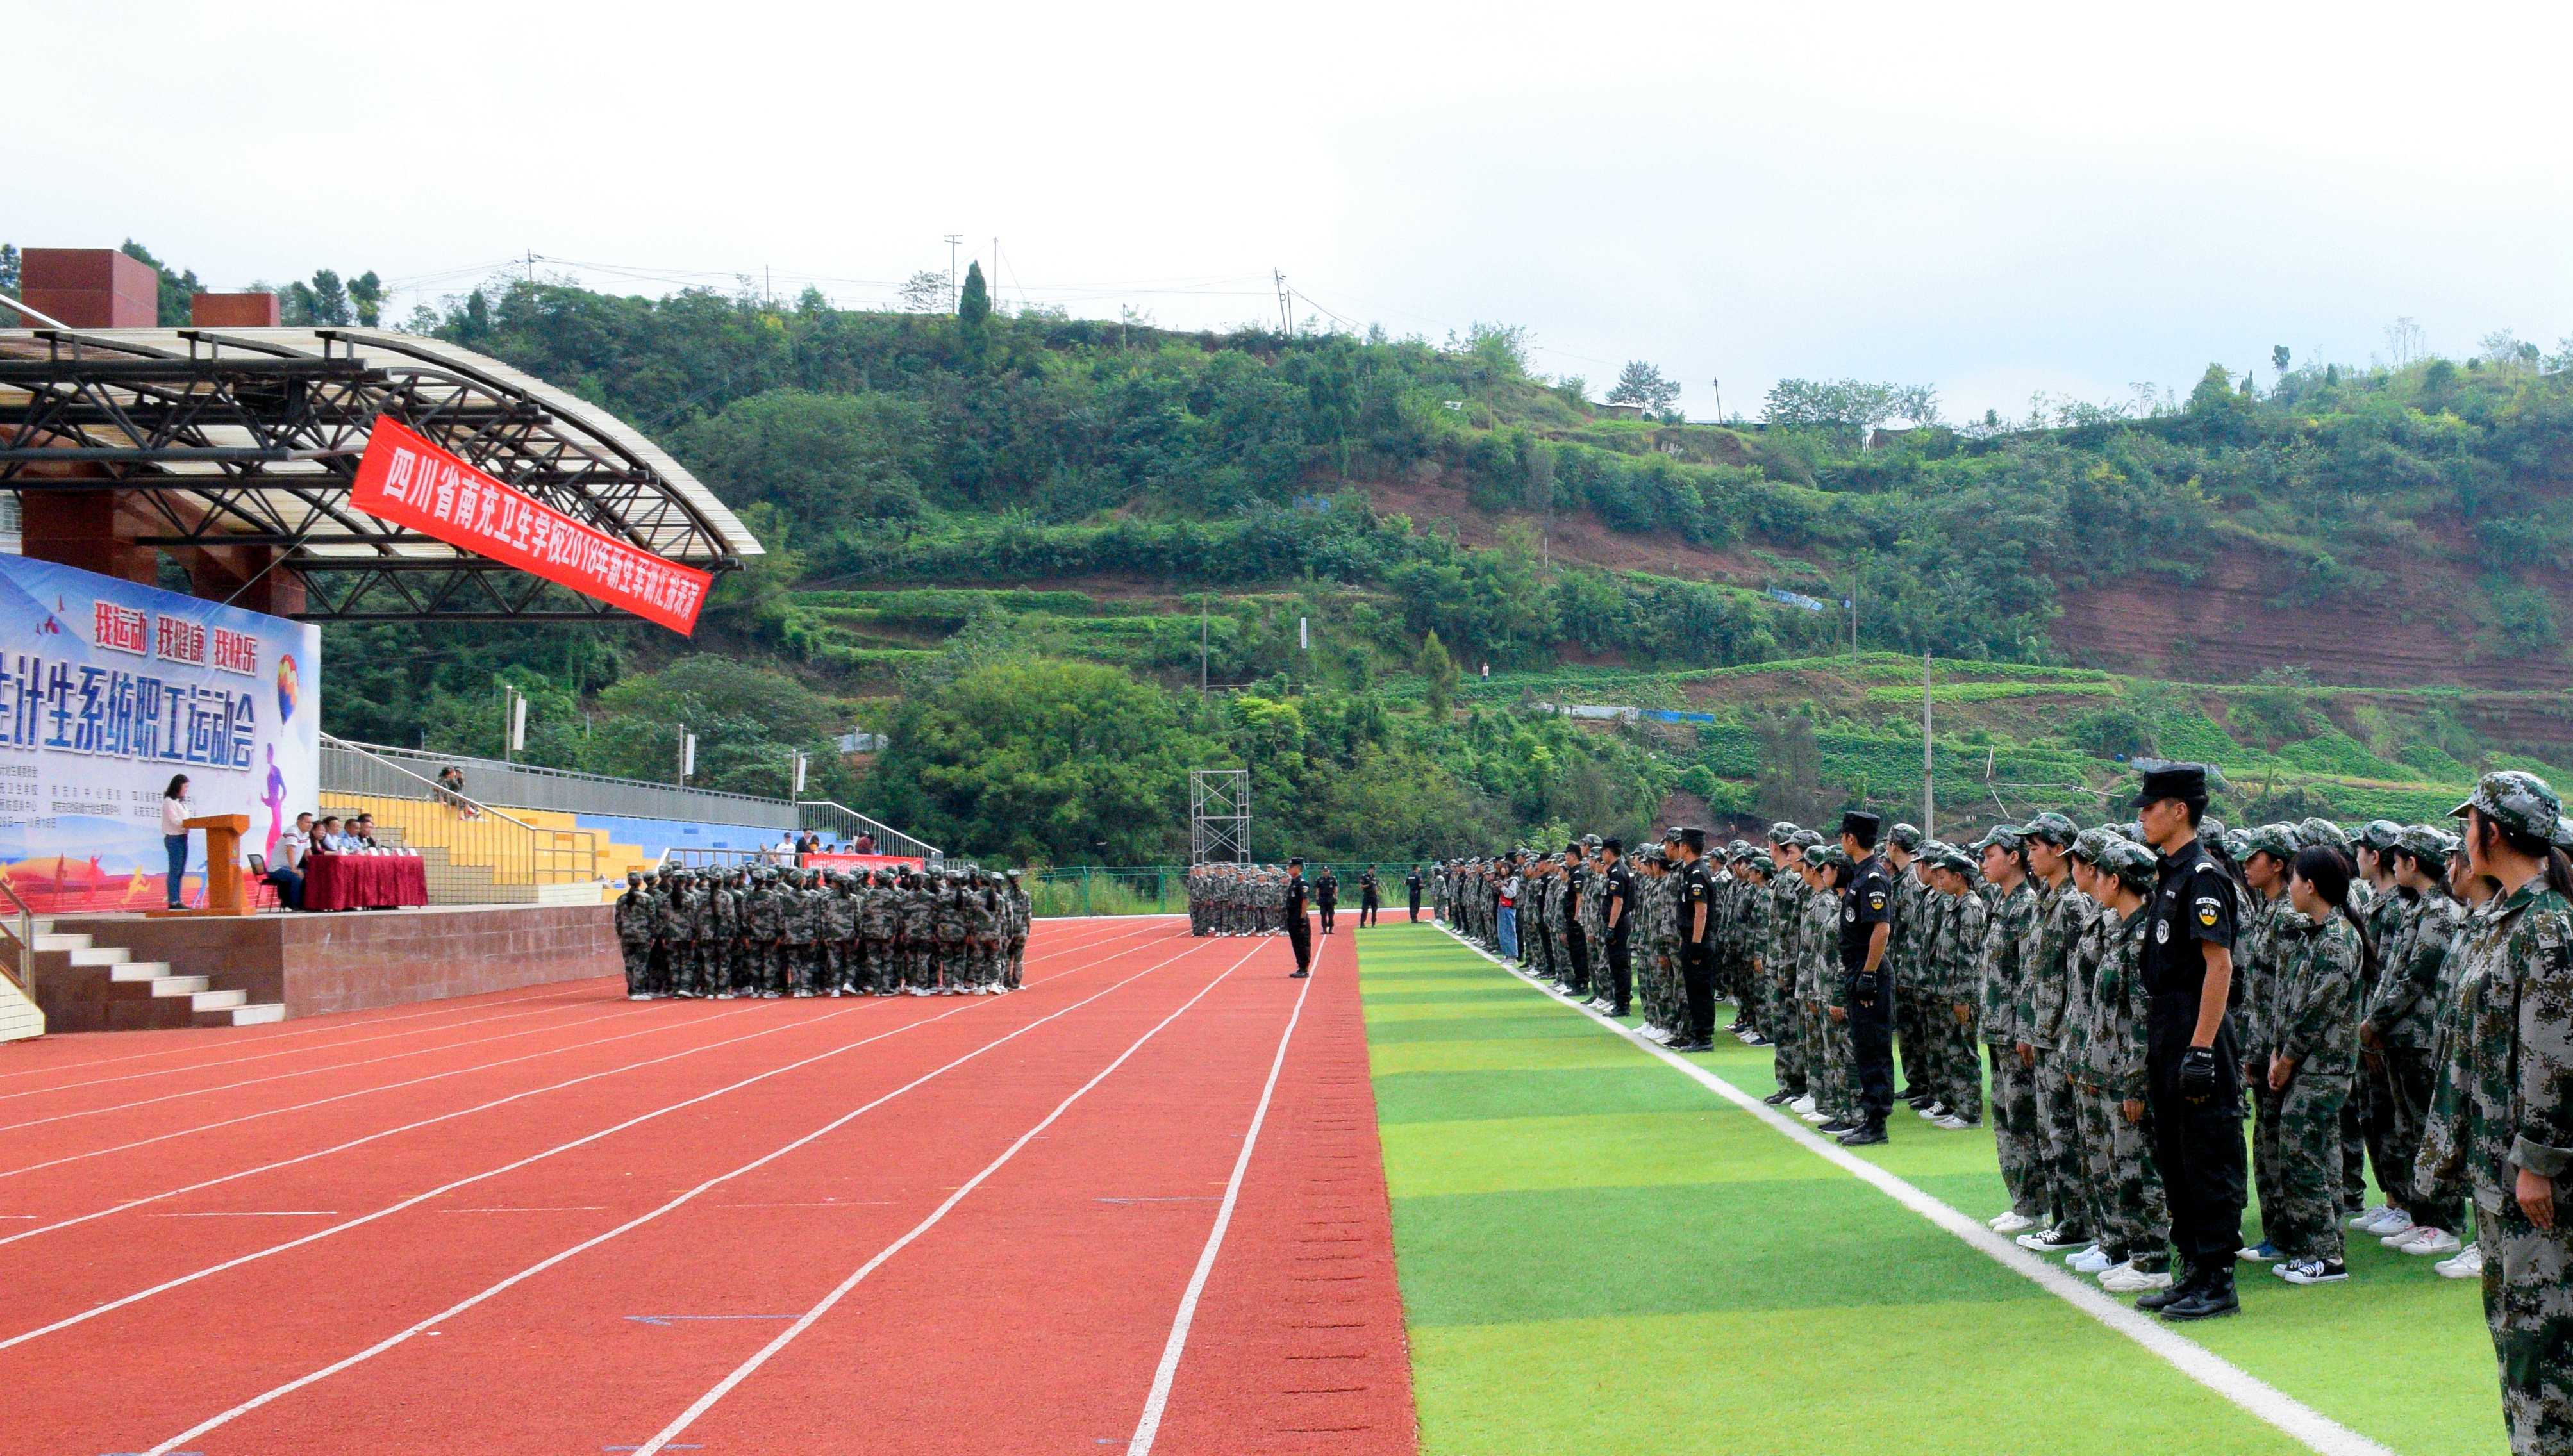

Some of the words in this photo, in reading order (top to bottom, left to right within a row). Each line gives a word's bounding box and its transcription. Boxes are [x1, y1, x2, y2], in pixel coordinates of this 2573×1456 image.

[383, 447, 700, 620] 四川省南充卫生学校2018年新生军训汇报表演
[95, 602, 147, 652] 我运动
[158, 616, 206, 664] 我健康
[215, 628, 257, 674] 我快乐
